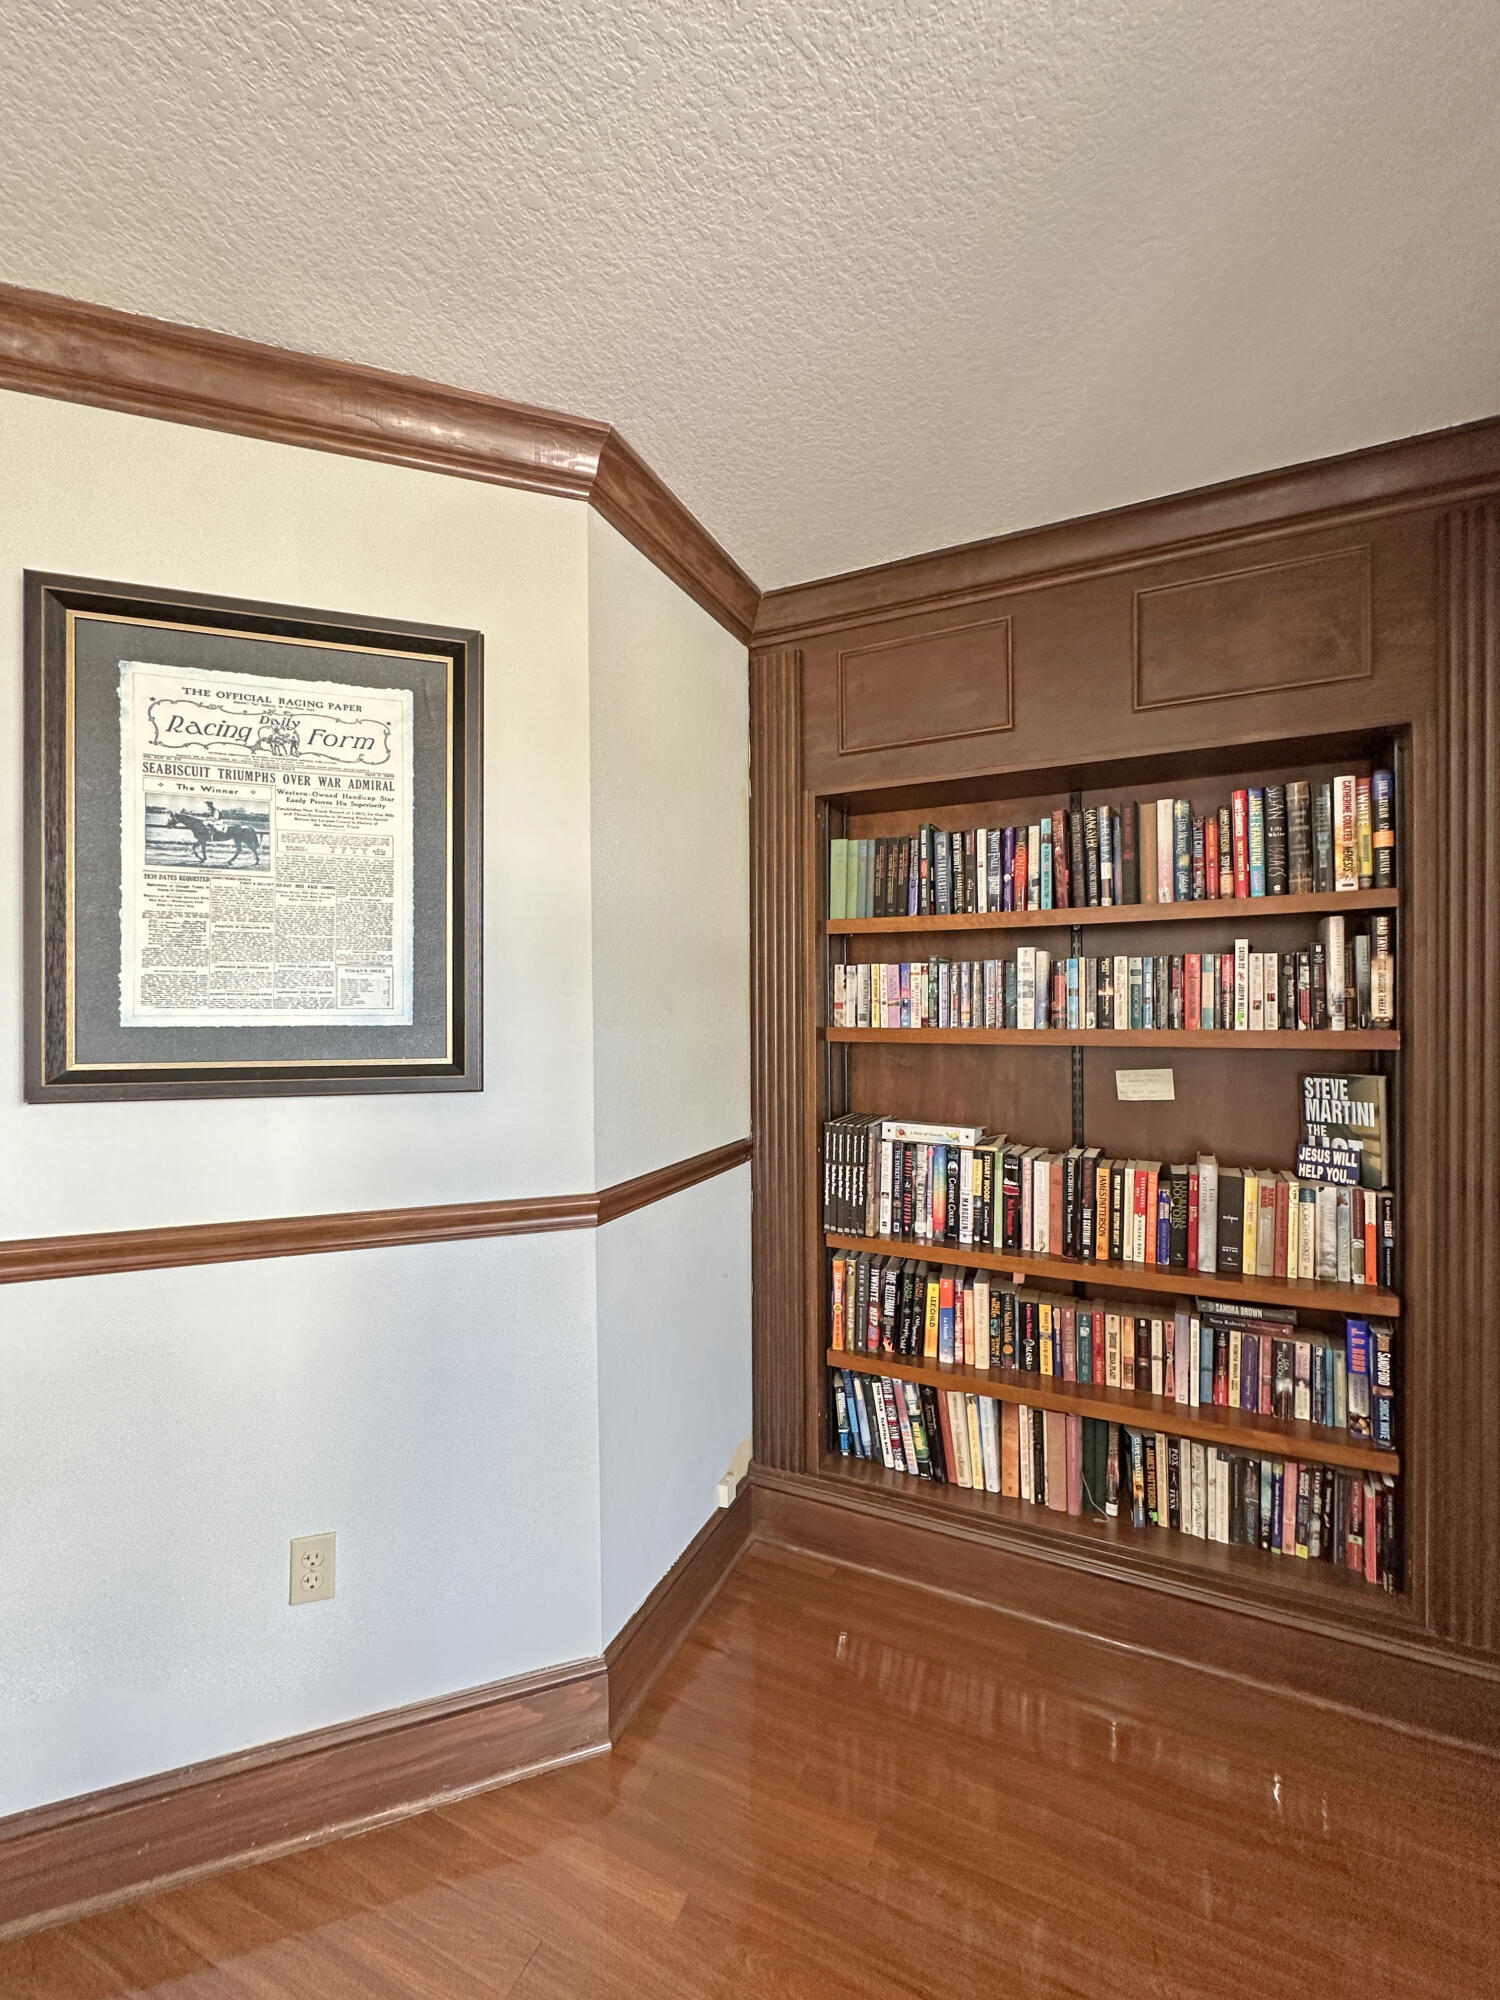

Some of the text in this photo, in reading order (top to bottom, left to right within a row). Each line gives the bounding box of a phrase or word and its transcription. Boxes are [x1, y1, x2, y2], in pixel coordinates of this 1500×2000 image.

[182, 686, 363, 714] THE OFFICIAL RACING PAPER
[166, 715, 375, 751] Racing Form
[259, 714, 301, 730] Daily
[142, 762, 395, 792] SEABISCUIT TRIUMPHS OVER WAR ADMIRAL
[176, 783, 239, 795] The Winner
[342, 792, 376, 802] Handicap
[350, 801, 386, 810] Superiority
[1266, 786, 1286, 820] SUSAN
[1357, 793, 1370, 826] WHITE
[953, 833, 963, 849] DEAN
[1085, 810, 1097, 849] GANGSTER
[1101, 820, 1110, 861] ARUBA
[1220, 825, 1230, 853] PATTERSON
[1250, 796, 1263, 867] JANET EVANOVICH
[1342, 780, 1354, 873] CATHERINE COULTER NEMESIS
[1194, 828, 1203, 858] LEE CHILD
[953, 850, 963, 872] KOONTZ
[1016, 842, 1027, 875] KOONTZ
[1268, 844, 1287, 878] ISAACS
[178, 875, 210, 883] REQUESTED
[938, 860, 948, 902] FRANKENSTEIN
[1377, 917, 1388, 1016] BRAD TAYLOR INSIDER THREAT
[1304, 1077, 1349, 1101] STEVE
[1305, 1098, 1375, 1128] MARTINI
[1307, 1123, 1328, 1137] THE
[1299, 1147, 1358, 1168] JESUS WILL
[1298, 1163, 1357, 1186] HELP YOU...
[904, 1193, 912, 1224] CRICHTON
[948, 1178, 957, 1226] CATHERINE COULTER
[961, 1198, 970, 1230] MARGOLIN
[1099, 1175, 1107, 1237] JAMES PATTERSON
[1172, 1181, 1182, 1229] DOCTORS
[1222, 1214, 1239, 1223] eclipse
[870, 1276, 880, 1326] WHITE DEEP
[884, 1271, 896, 1317] FAYE KELLERMAN
[929, 1308, 937, 1328] CHILD
[1209, 1317, 1246, 1327] Nora Roberts
[1215, 1303, 1263, 1318] SANDRA BROWN
[902, 1319, 911, 1338] Deeply
[1352, 1328, 1366, 1373] J. D. ROBB
[1377, 1334, 1391, 1440] JOHN SANDFORD SHOCK WAVE
[924, 1403, 934, 1421] Arco
[1134, 1455, 1142, 1481] CUSSLER
[1171, 1448, 1179, 1466] POX
[1146, 1448, 1156, 1509] JAMES PATTERSON
